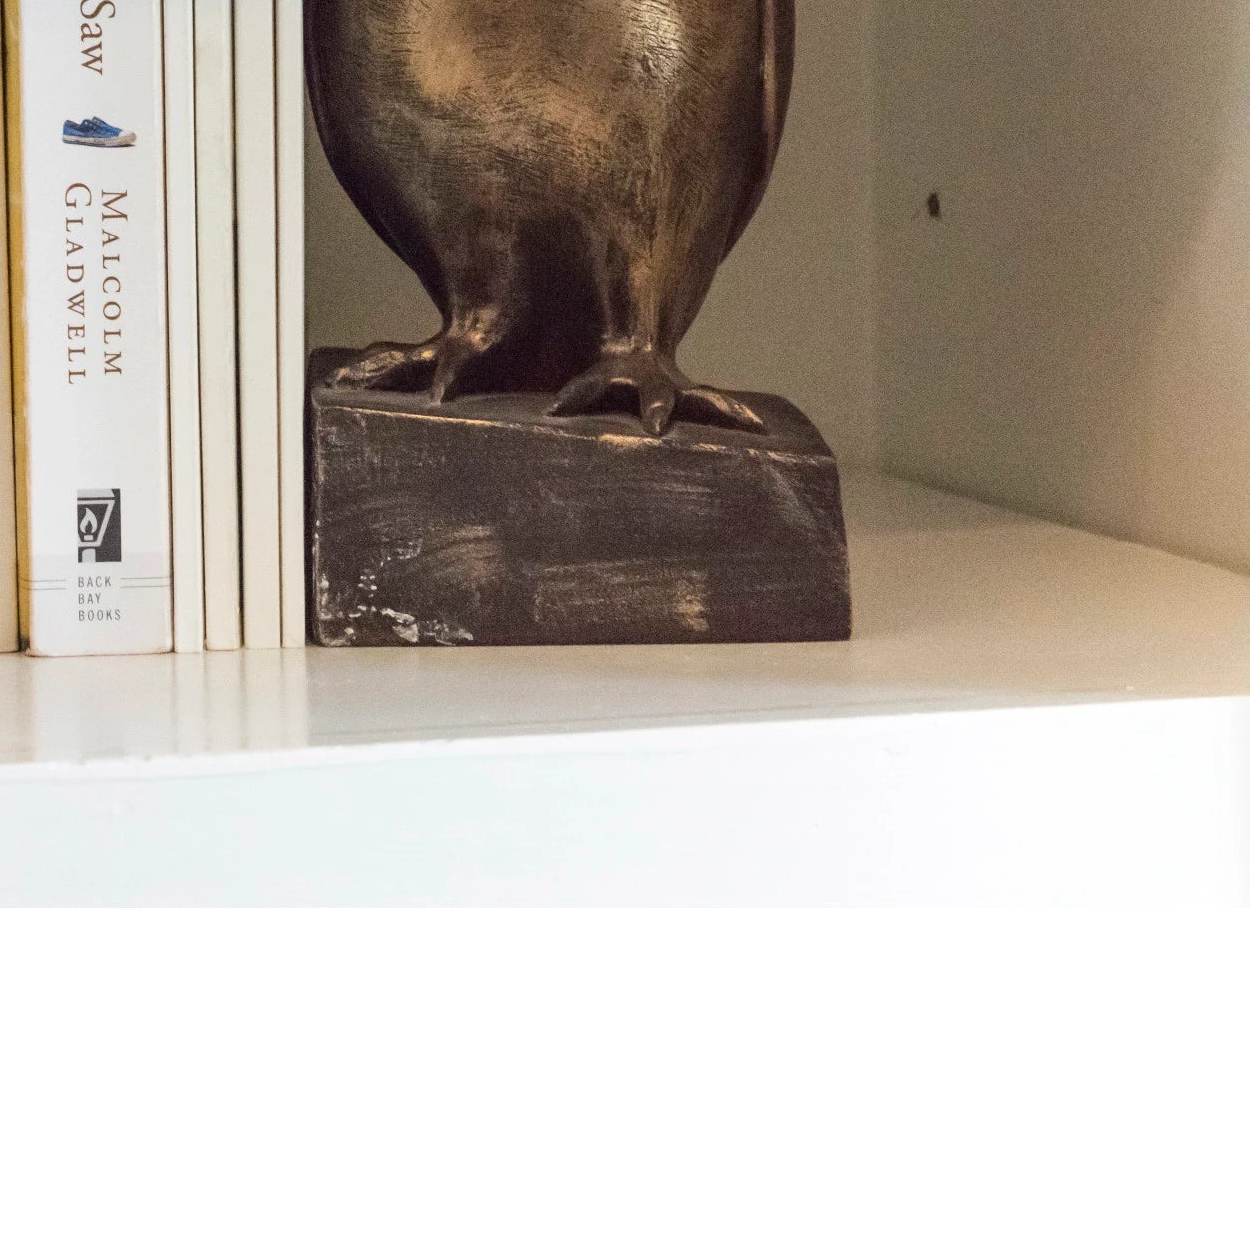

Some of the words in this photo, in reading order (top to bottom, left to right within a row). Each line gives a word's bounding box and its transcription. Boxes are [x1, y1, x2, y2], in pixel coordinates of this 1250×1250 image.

[65, 182, 92, 384] GLADWELL
[101, 189, 128, 375] MALCOLM
[78, 576, 112, 588] BACK
[78, 593, 101, 605] BAY
[78, 609, 121, 622] BOOKS
